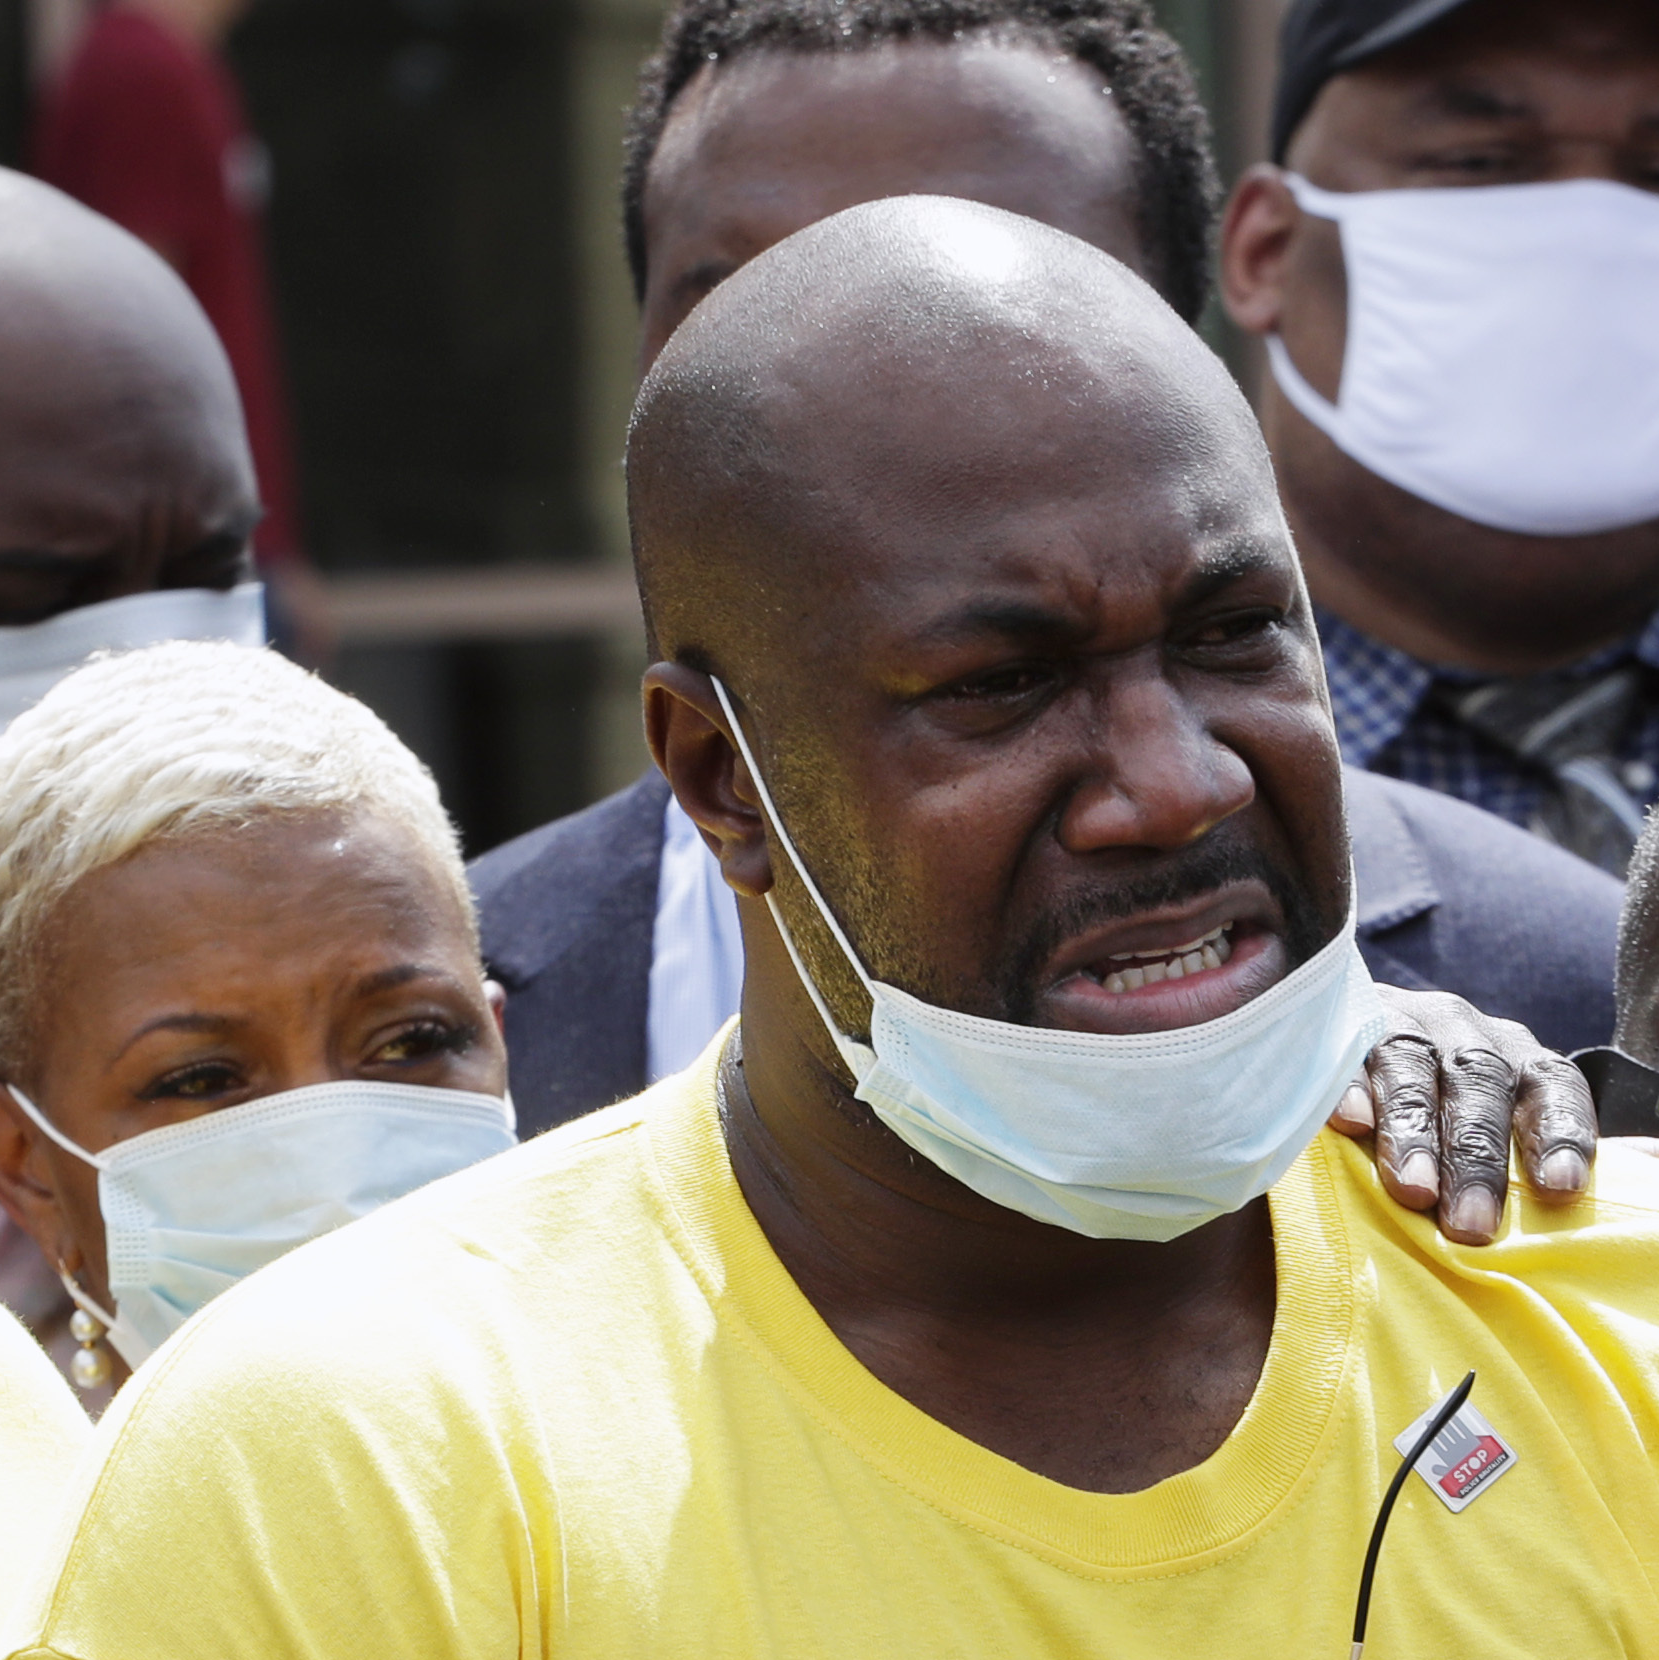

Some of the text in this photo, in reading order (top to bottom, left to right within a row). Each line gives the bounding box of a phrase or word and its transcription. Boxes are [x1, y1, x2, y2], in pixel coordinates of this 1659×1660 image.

[1453, 1449, 1488, 1483] STOP
[1460, 1453, 1507, 1496] POLICE BRUTALITY
